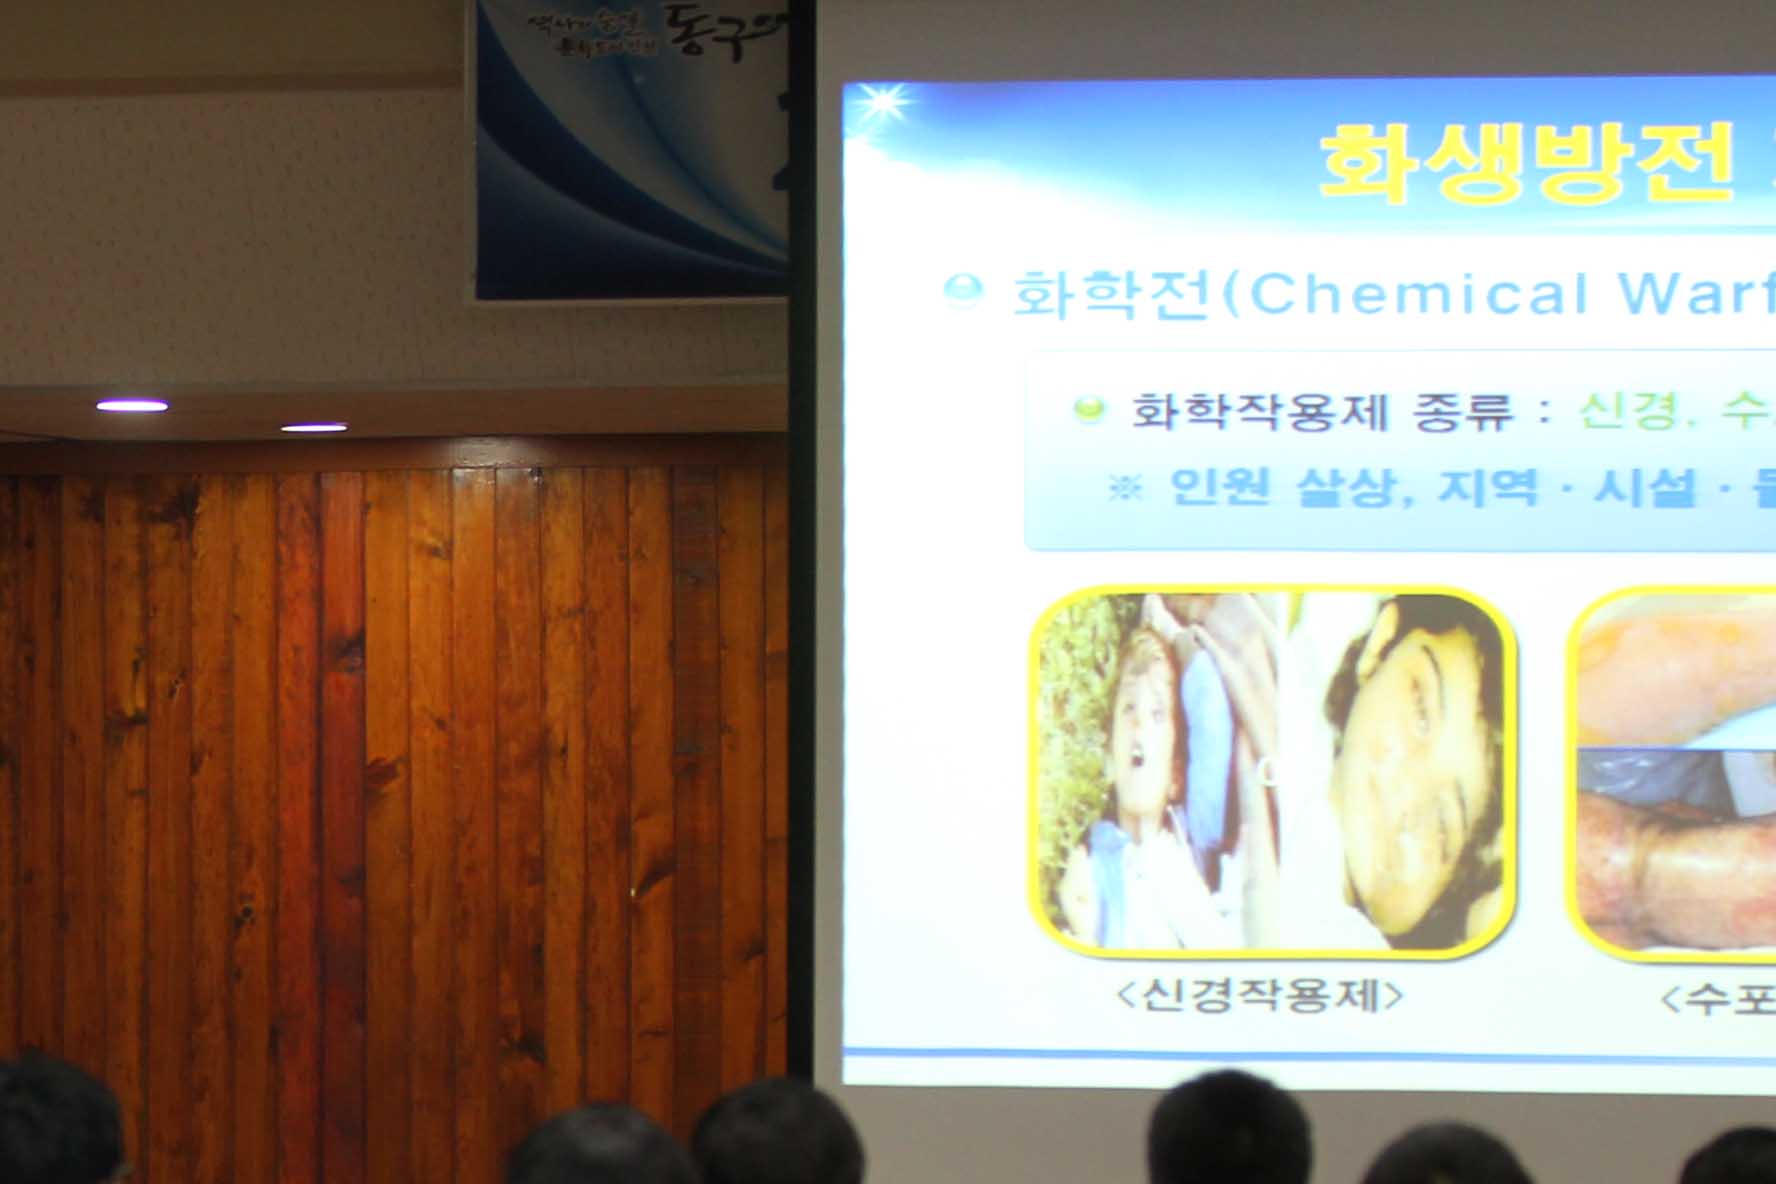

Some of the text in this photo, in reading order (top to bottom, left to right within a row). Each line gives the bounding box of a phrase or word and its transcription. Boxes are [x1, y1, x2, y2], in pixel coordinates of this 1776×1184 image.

[1320, 122, 1734, 206] 화생방전
[1013, 269, 1586, 321] 화학전(Chemical
[1132, 393, 1387, 433] 화학작용제
[1412, 392, 1515, 433] 종류
[1721, 390, 1776, 430] 수
[1170, 466, 1271, 506] 인원
[1296, 468, 1415, 510] 살상,
[1437, 467, 1538, 509] 지역
[1593, 467, 1696, 510] 시설
